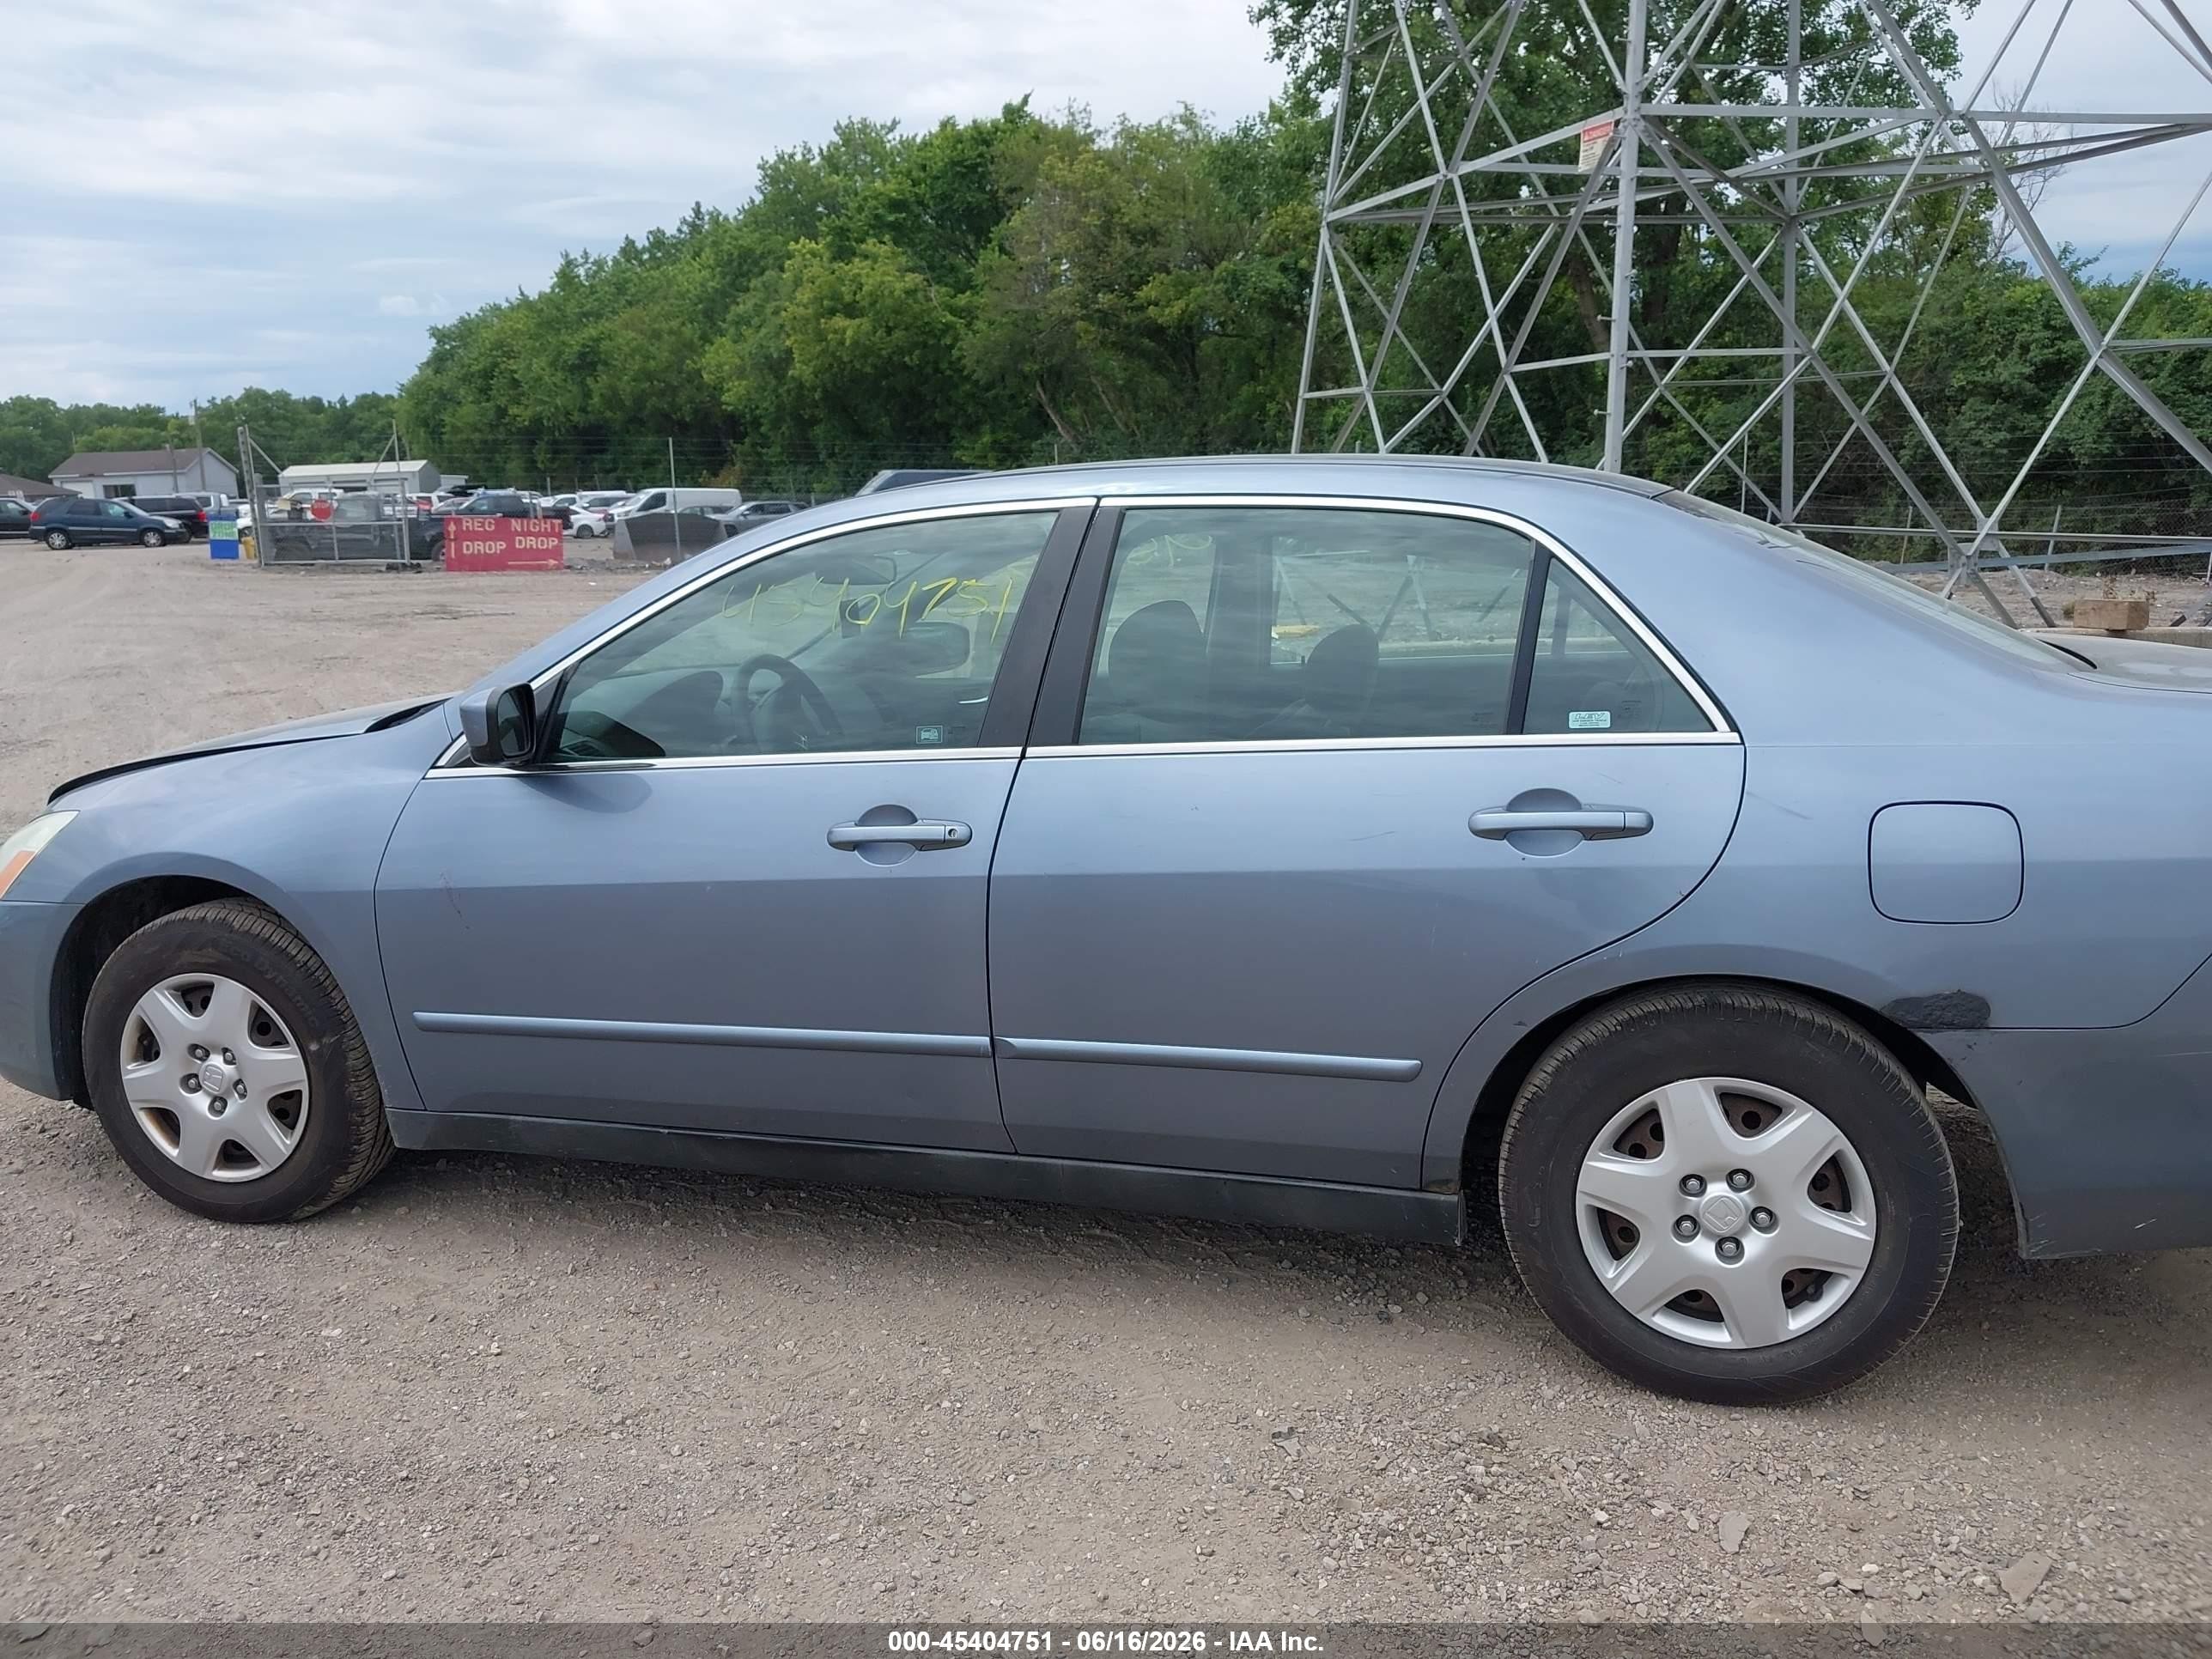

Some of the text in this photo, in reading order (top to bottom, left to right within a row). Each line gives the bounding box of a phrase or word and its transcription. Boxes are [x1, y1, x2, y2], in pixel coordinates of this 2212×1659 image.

[463, 519, 495, 531] REG
[511, 519, 562, 532] NIGHT
[463, 541, 507, 555] DROP
[515, 536, 558, 550] DROP
[723, 576, 1013, 646] 45404751
